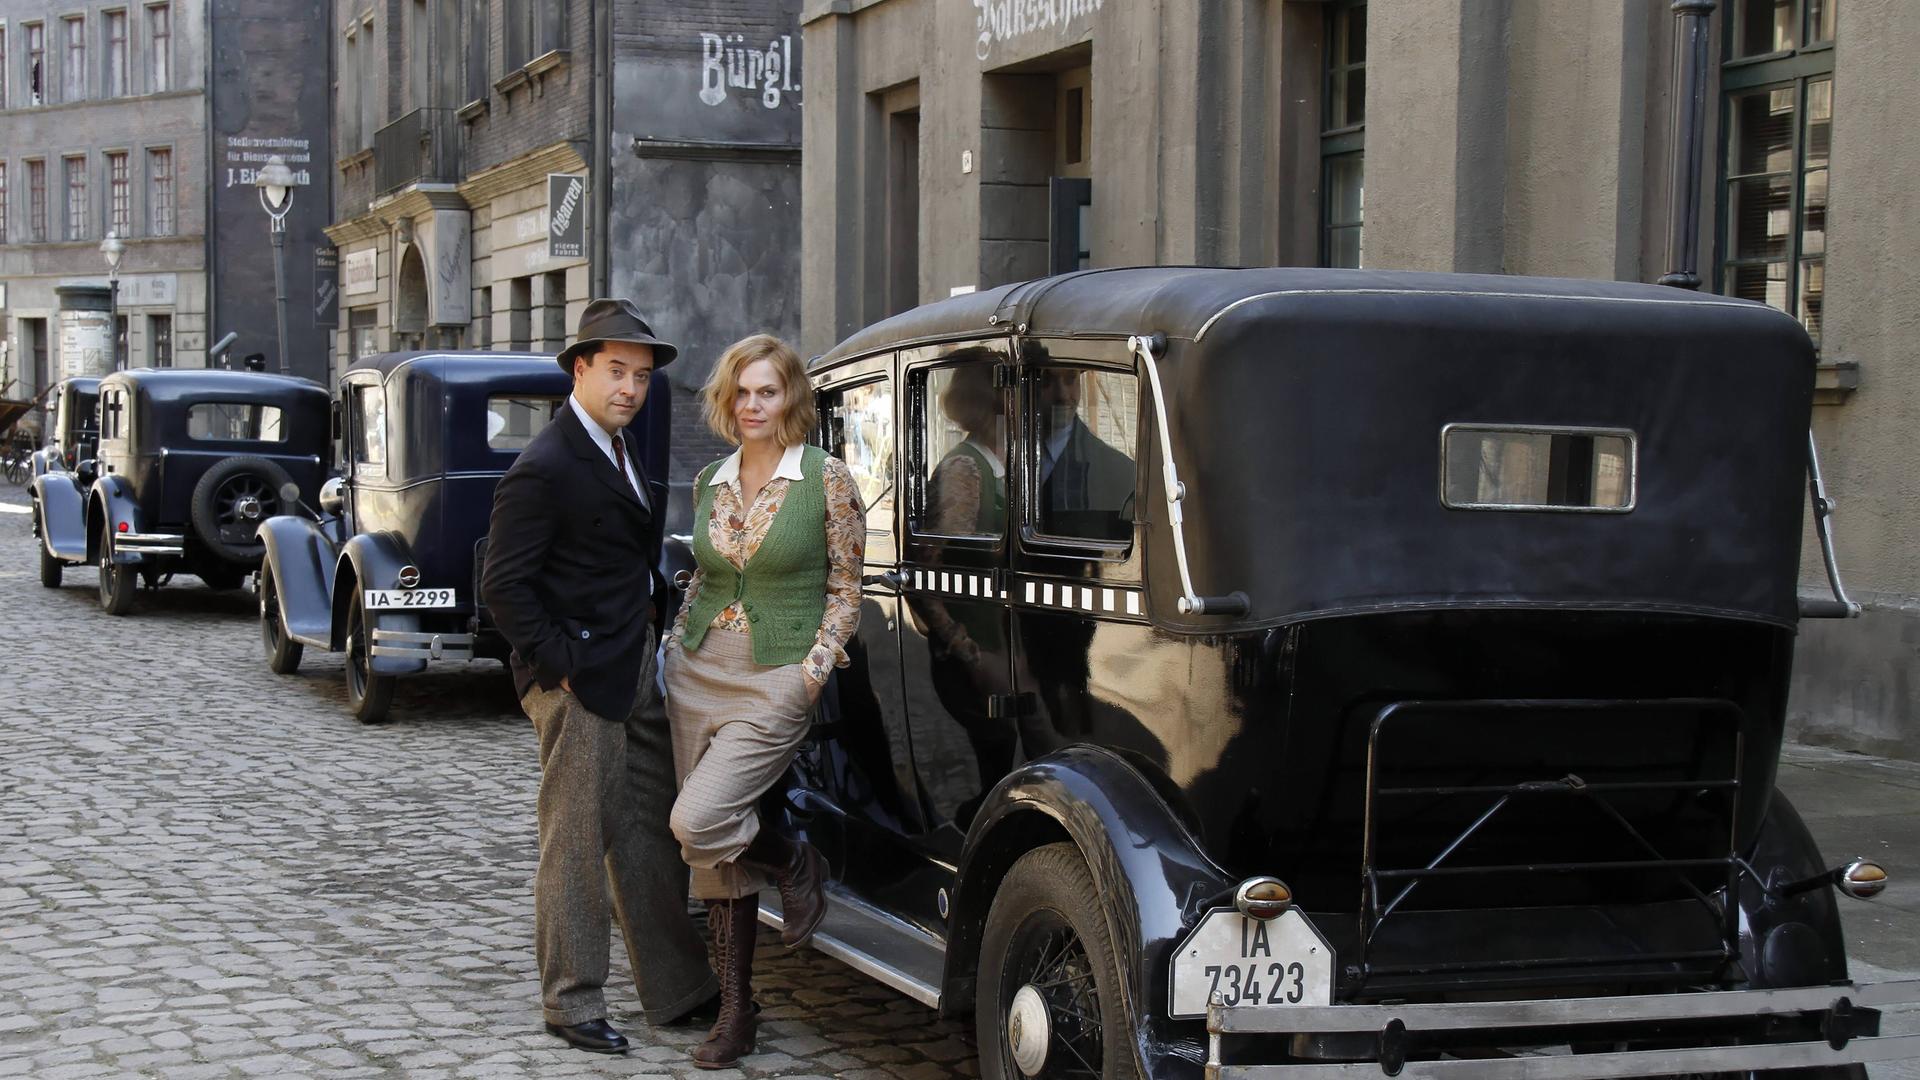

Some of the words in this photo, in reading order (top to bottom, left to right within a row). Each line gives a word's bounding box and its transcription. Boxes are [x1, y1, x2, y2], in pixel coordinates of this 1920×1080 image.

[226, 168, 238, 188] J.
[551, 178, 583, 237] Cigarren
[1241, 917, 1271, 958] IA
[1204, 962, 1304, 1006] 73423
